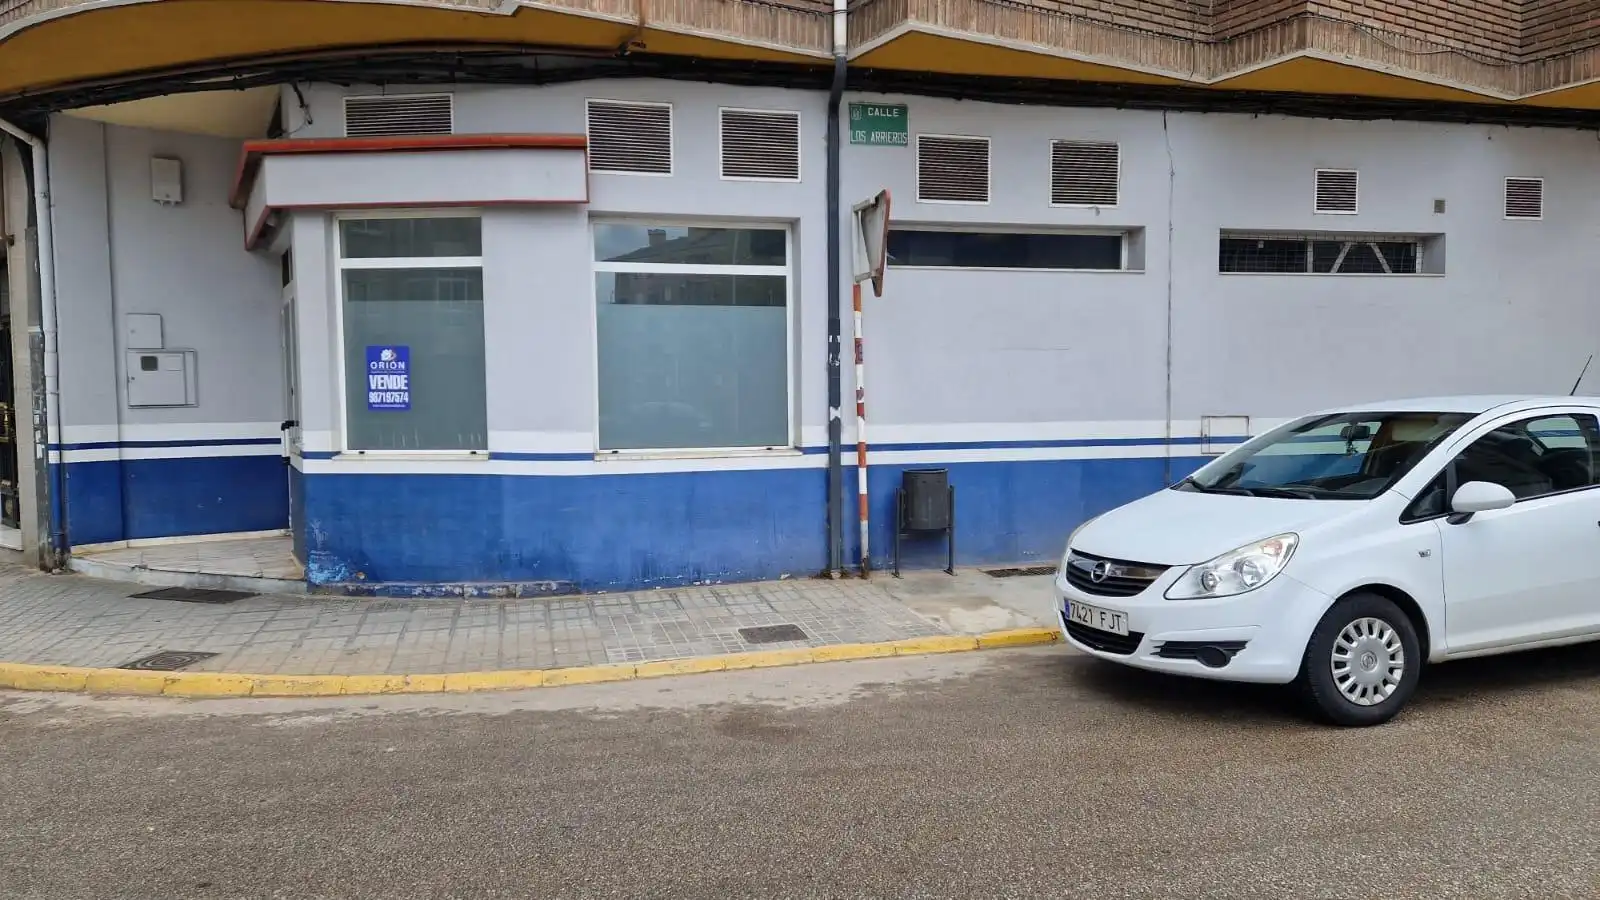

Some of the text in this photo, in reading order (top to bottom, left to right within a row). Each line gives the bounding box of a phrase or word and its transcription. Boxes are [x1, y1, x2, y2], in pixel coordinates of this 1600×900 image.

[868, 107, 899, 117] CALLE
[851, 130, 908, 144] LOS ARRIEROS
[369, 375, 408, 390] VENDE
[1070, 602, 1121, 631] 7421 FJT
